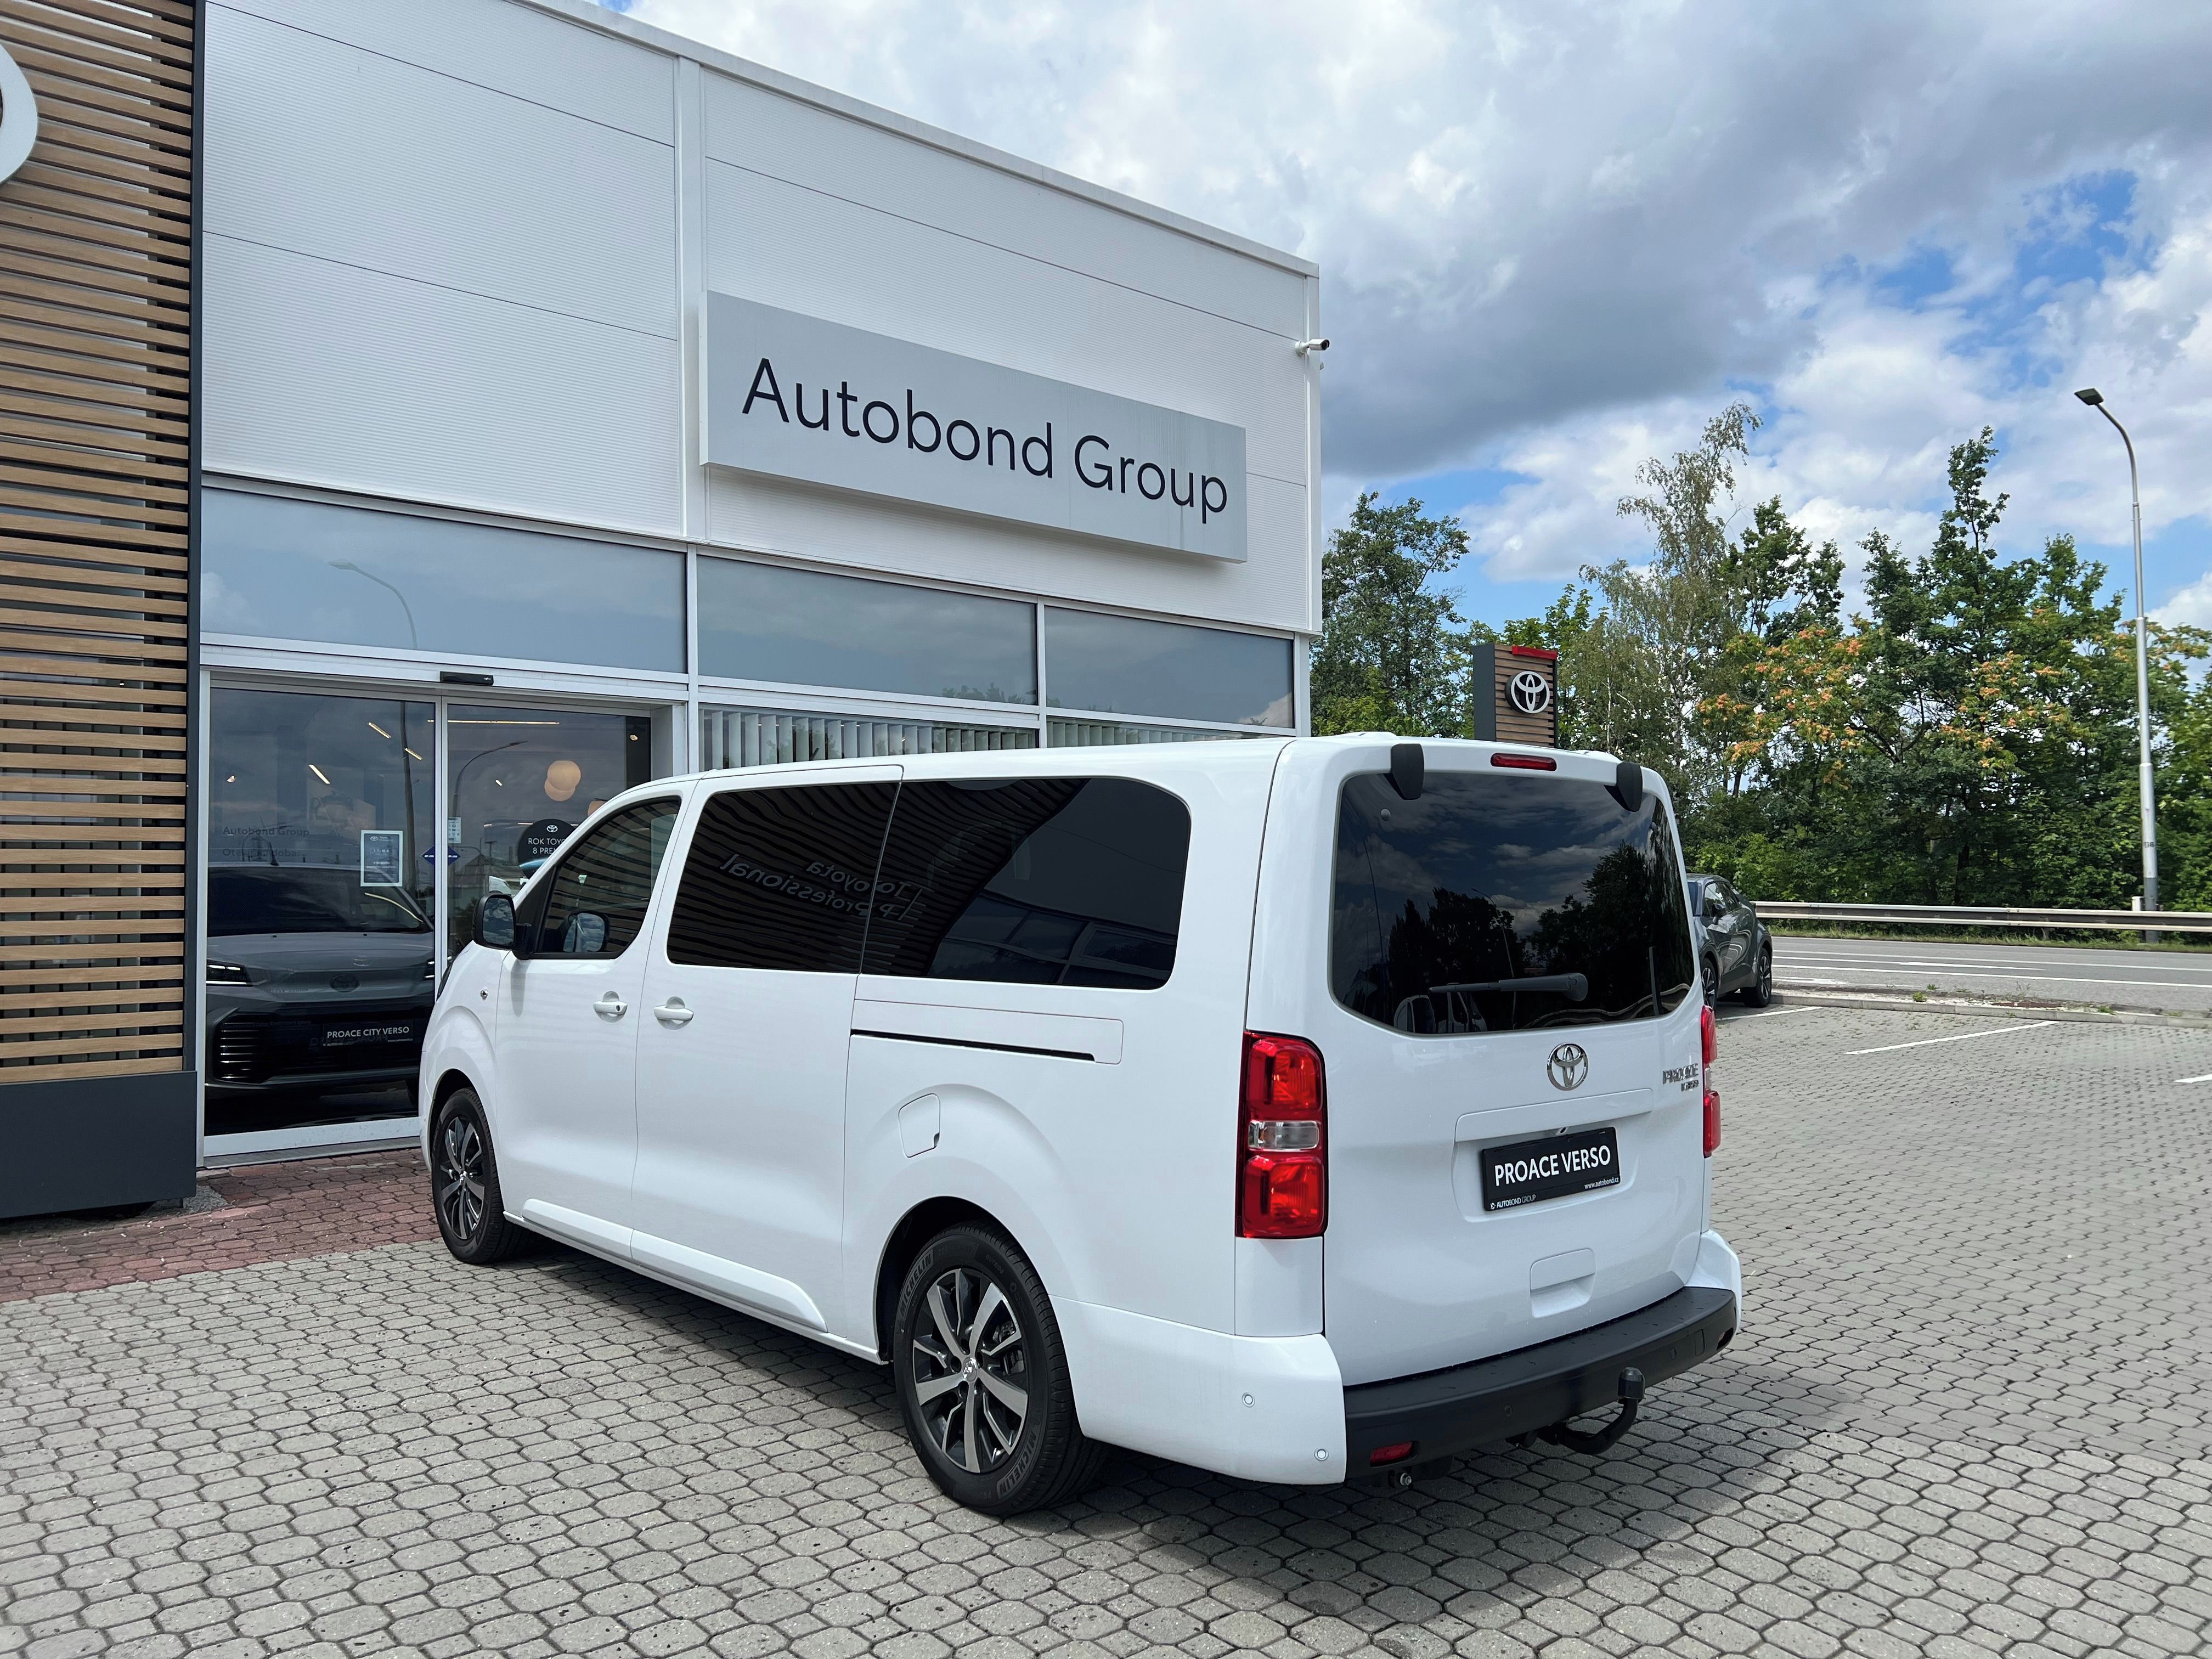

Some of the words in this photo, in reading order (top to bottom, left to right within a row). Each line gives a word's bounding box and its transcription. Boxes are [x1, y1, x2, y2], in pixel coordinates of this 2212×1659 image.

[742, 358, 1053, 479] Autobond
[1074, 435, 1228, 524] Group
[223, 826, 275, 836] Autobond
[278, 828, 309, 837] Group
[327, 1030, 361, 1039] PROACE
[363, 1028, 381, 1036] CITY
[382, 1026, 409, 1035] VERSO
[1494, 1155, 1559, 1187] PROACE
[1561, 1145, 1611, 1173] VERSO
[1496, 1197, 1521, 1209] AUTOBOND
[1521, 1194, 1536, 1203] GROUP
[899, 1252, 932, 1317] MICHELIN
[998, 1429, 1037, 1495] MICHELIN
